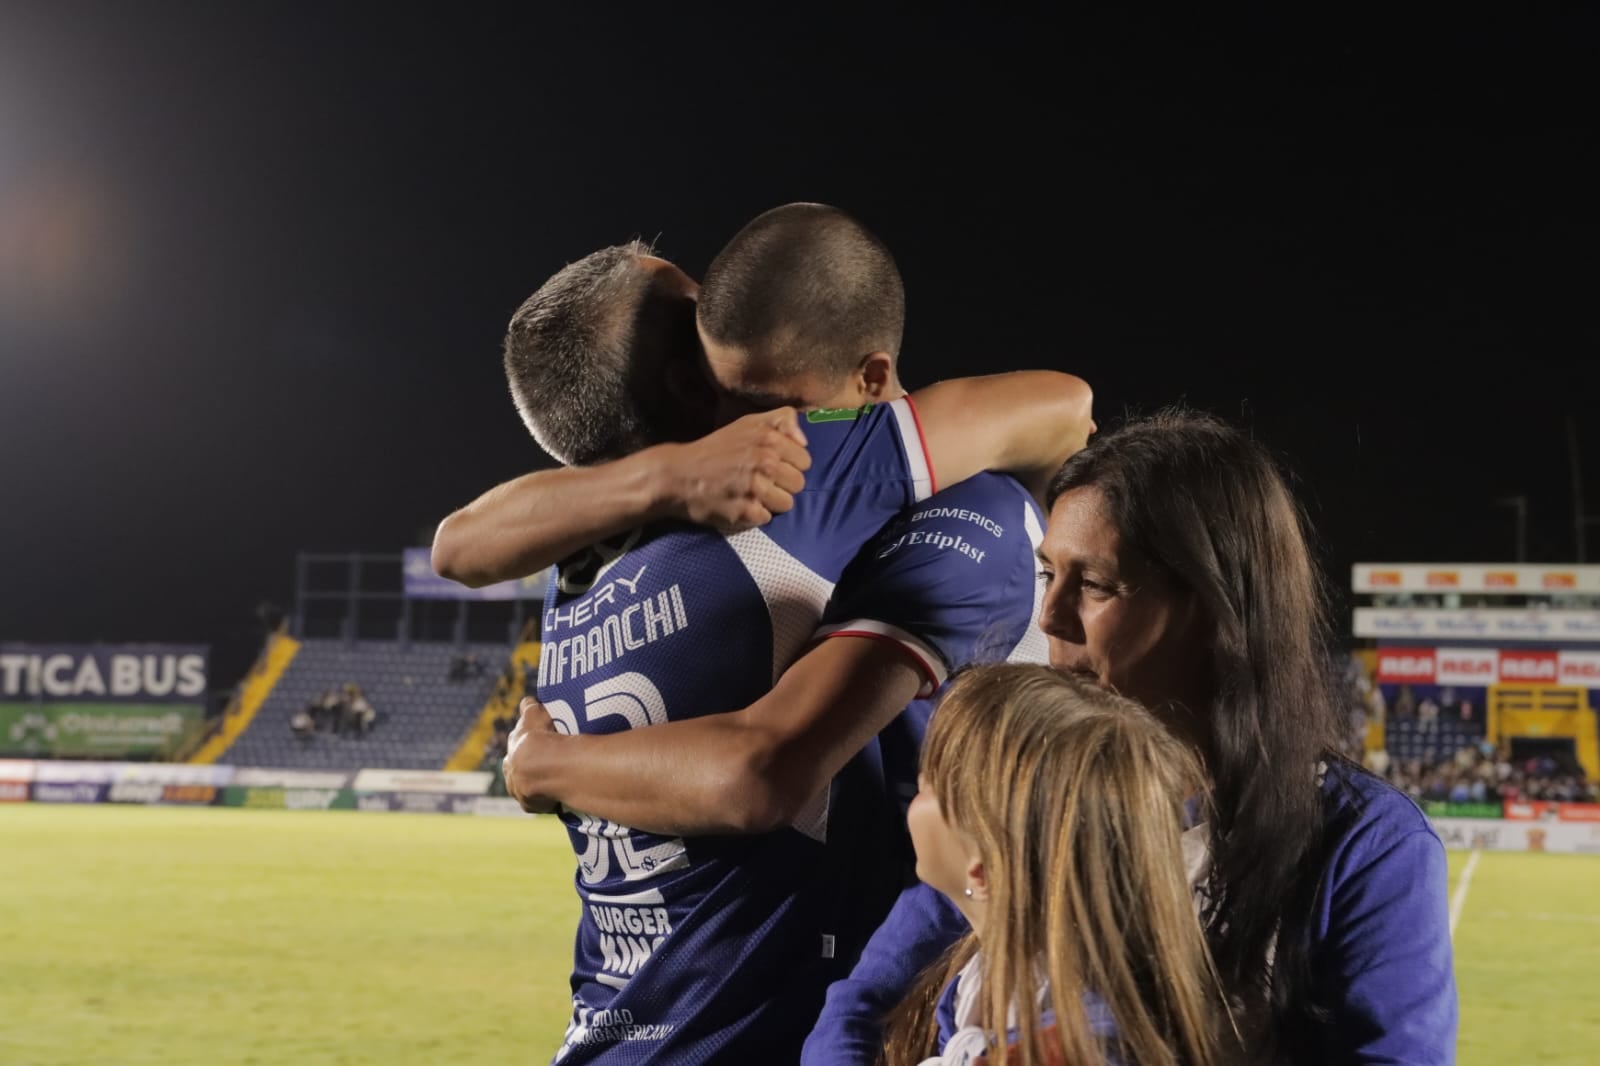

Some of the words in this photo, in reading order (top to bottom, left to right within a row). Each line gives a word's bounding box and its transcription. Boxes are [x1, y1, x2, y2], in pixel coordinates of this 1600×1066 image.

[911, 507, 1003, 539] BIOMERICS
[908, 531, 986, 564] Etiplast
[544, 565, 647, 632] CHERY
[0, 654, 105, 696] TICA
[111, 654, 205, 696] BUS
[589, 904, 673, 935] BURGER
